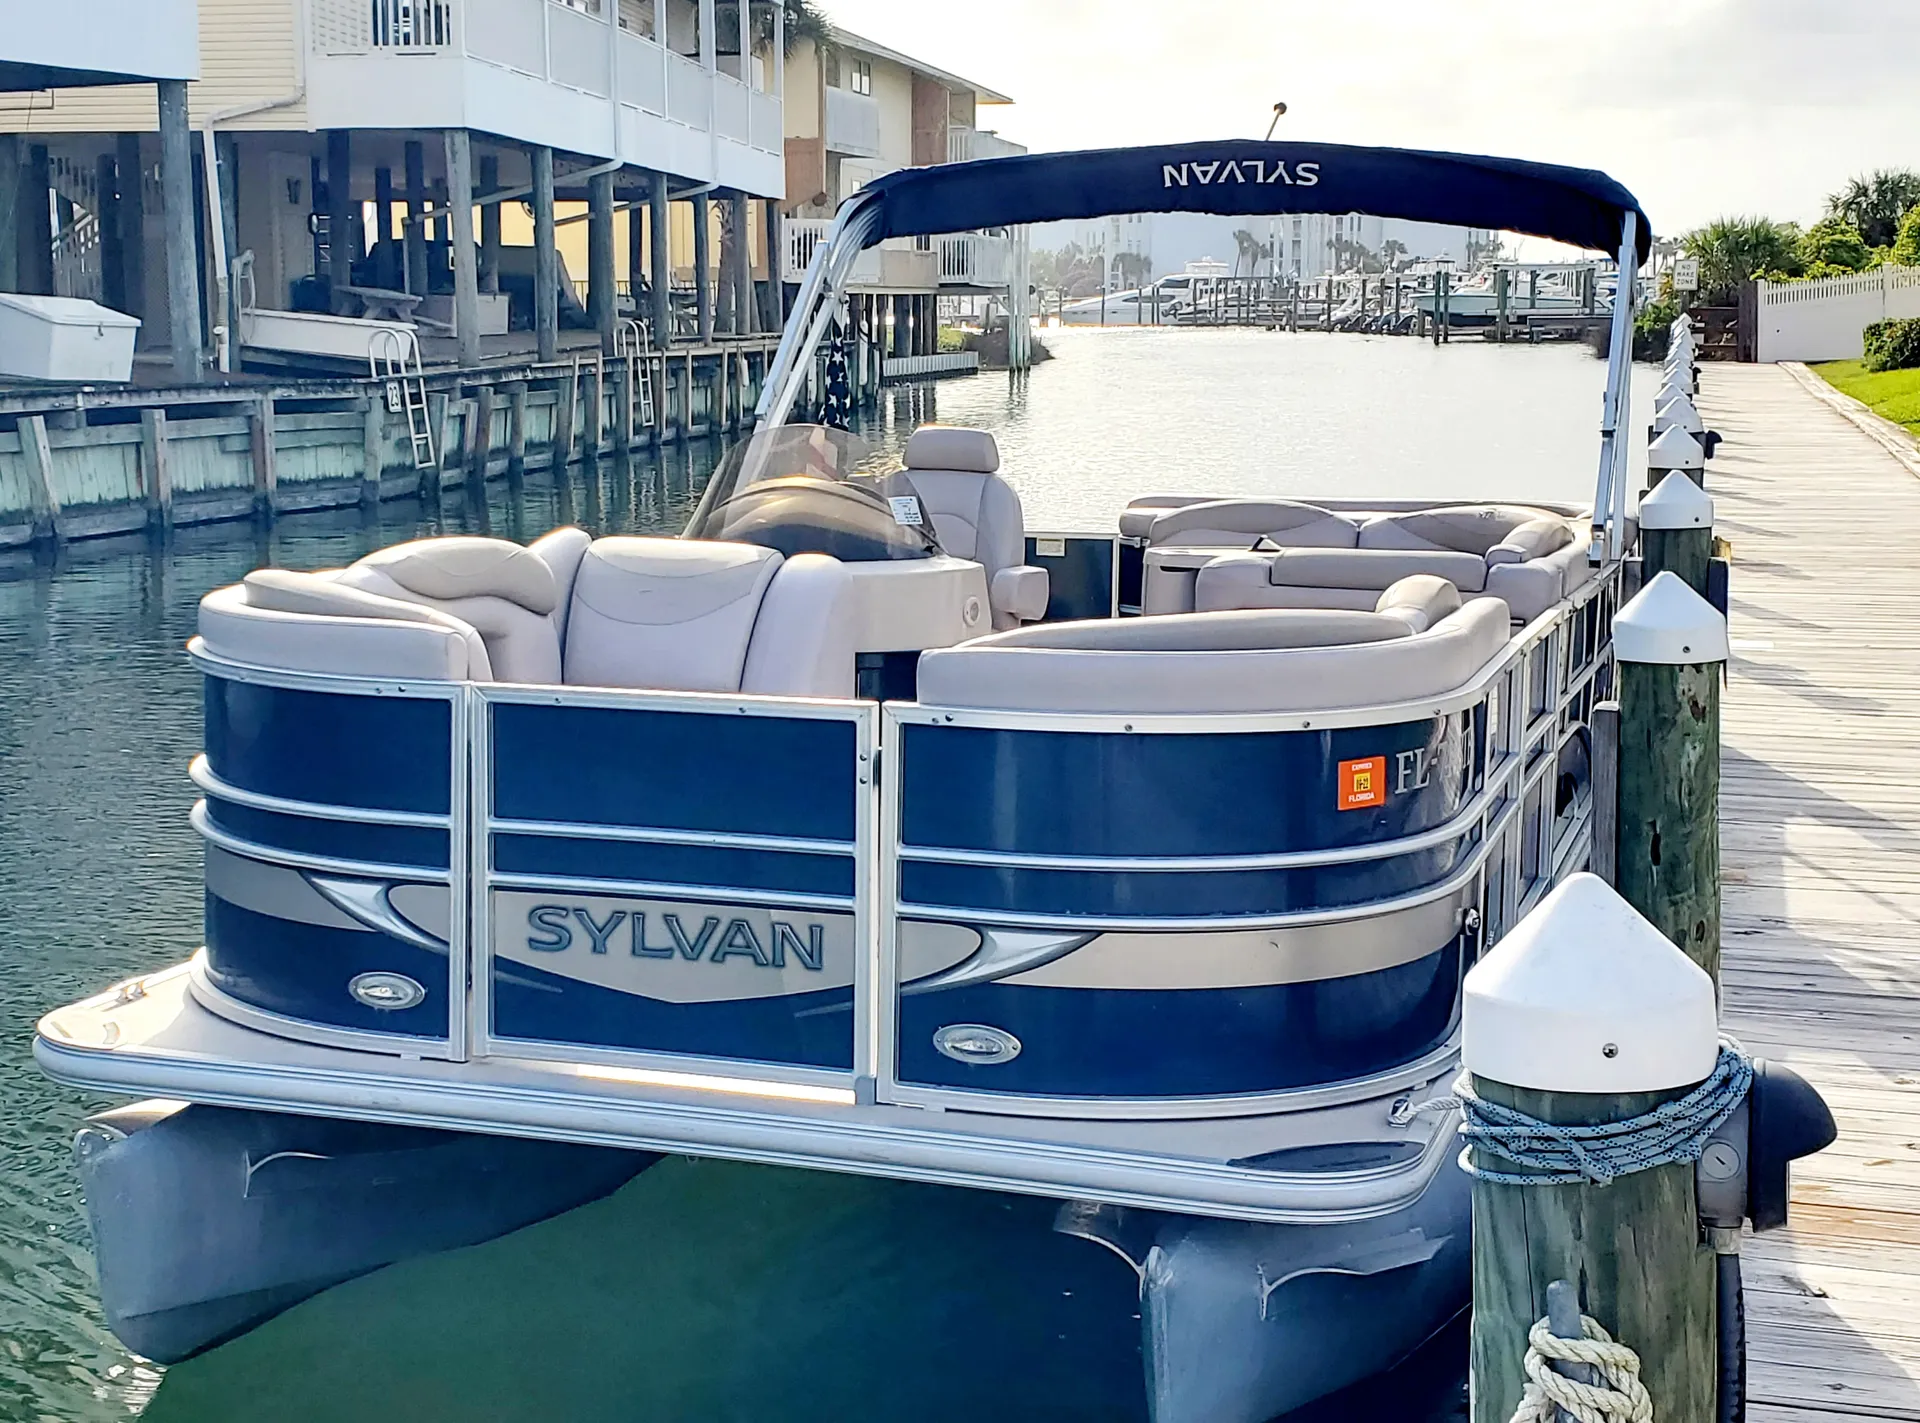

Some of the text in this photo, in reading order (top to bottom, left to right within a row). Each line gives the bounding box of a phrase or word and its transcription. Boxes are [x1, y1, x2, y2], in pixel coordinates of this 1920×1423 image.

[1162, 160, 1320, 188] SYLVAN
[389, 386, 399, 407] 23
[527, 906, 824, 970] SYLVAN
